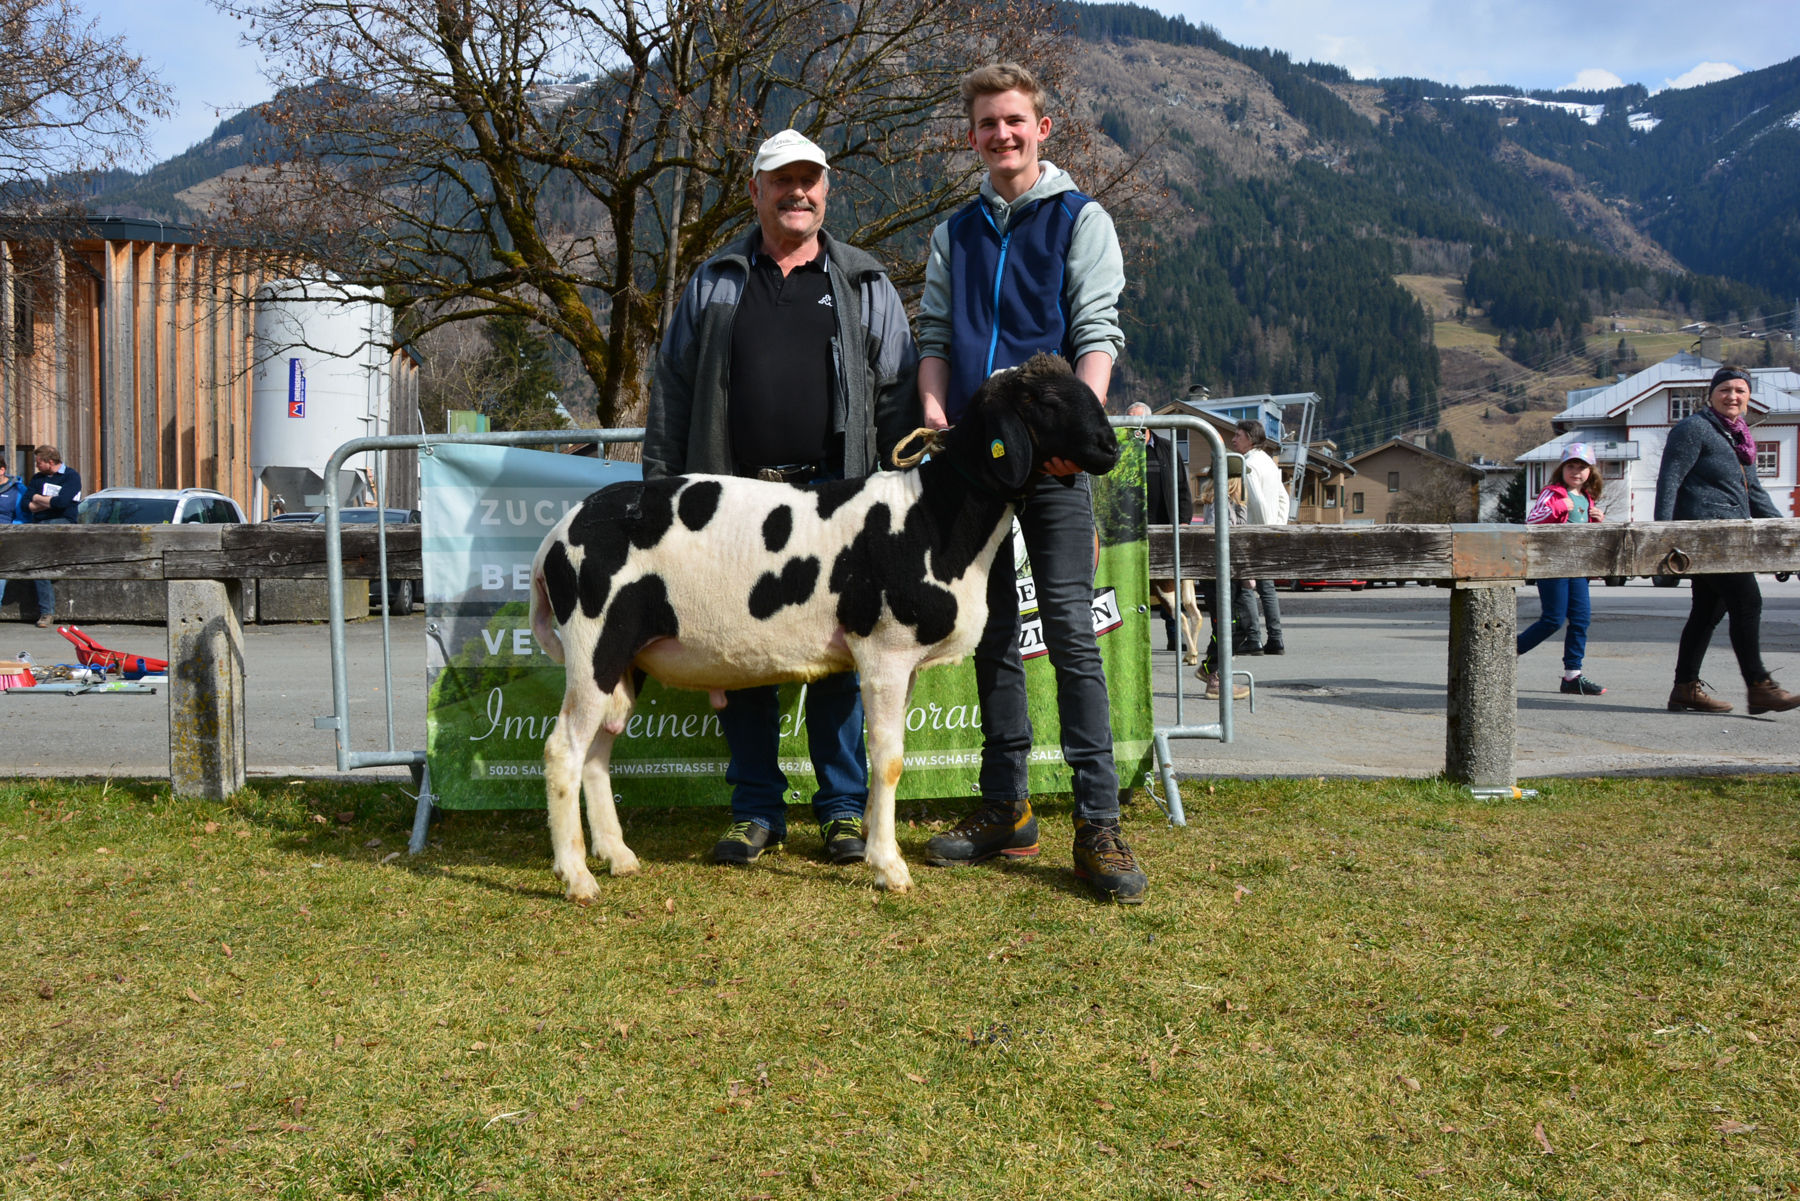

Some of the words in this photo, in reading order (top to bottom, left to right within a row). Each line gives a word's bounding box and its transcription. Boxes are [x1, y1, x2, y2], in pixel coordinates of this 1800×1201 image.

[481, 629, 546, 655] VE
[626, 699, 724, 738] einen
[489, 765, 518, 776] 5020
